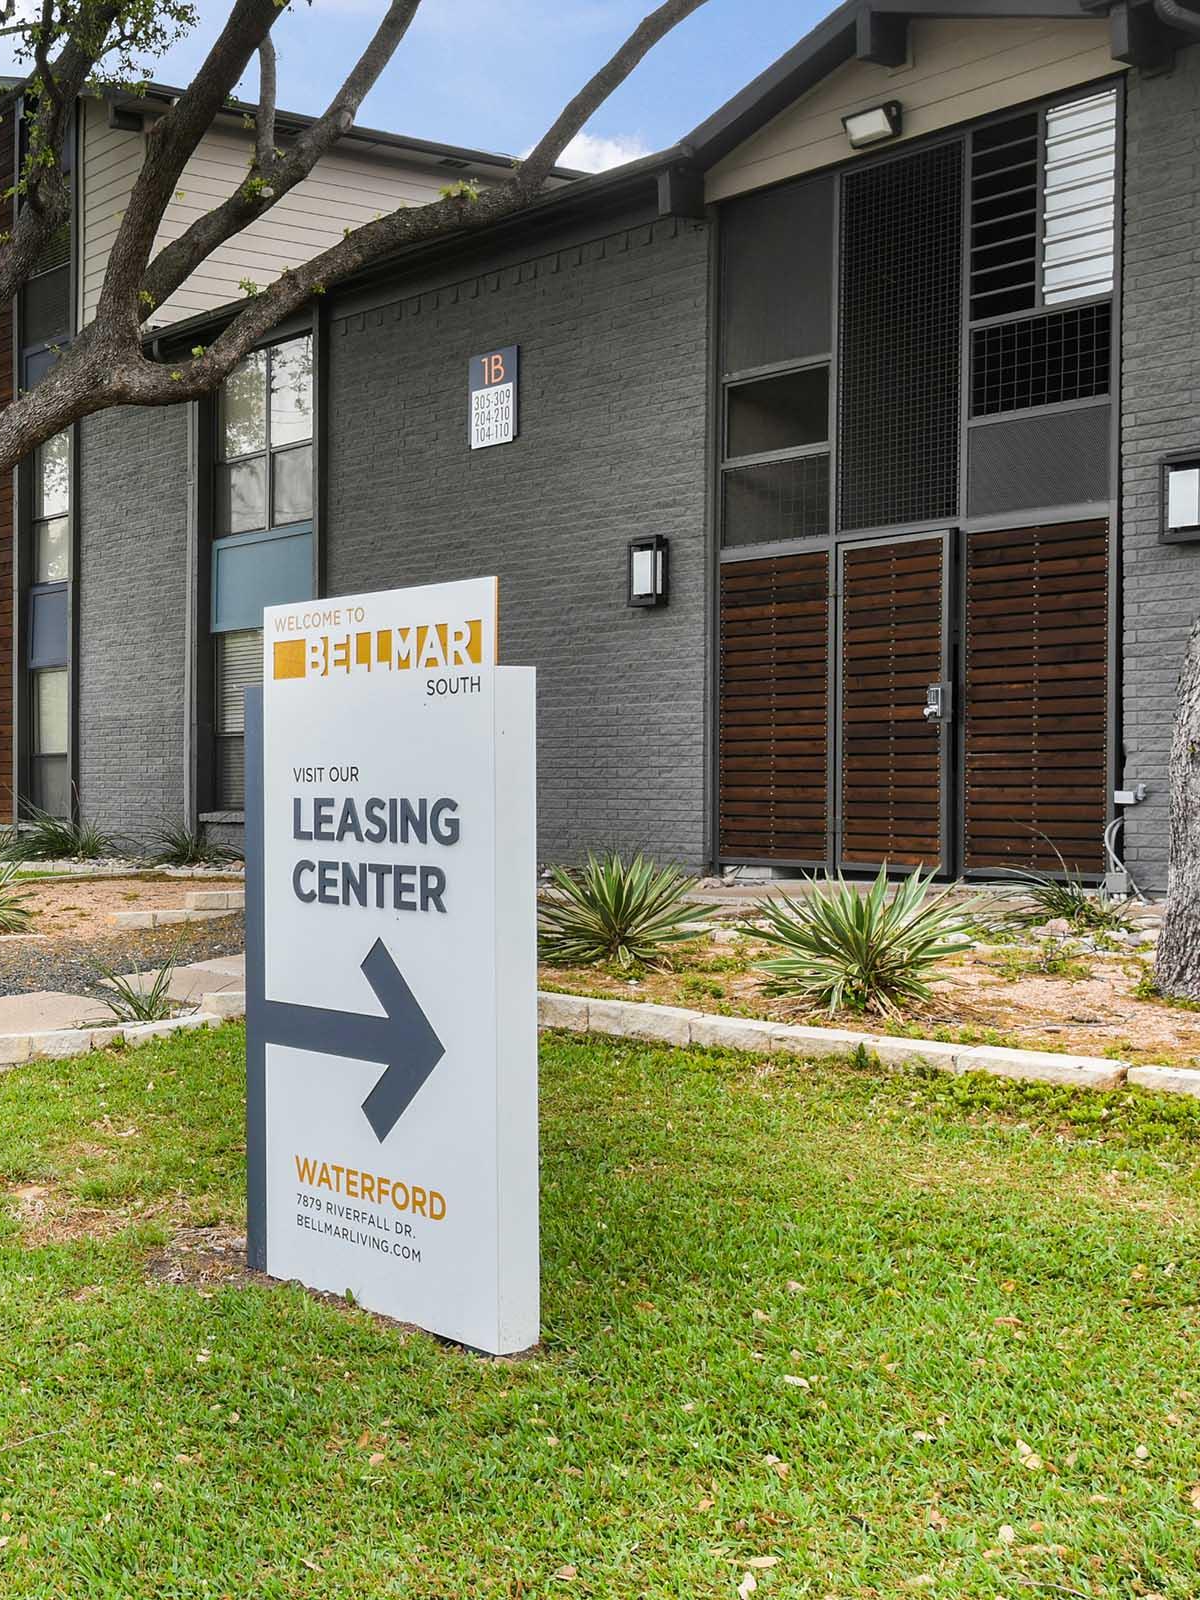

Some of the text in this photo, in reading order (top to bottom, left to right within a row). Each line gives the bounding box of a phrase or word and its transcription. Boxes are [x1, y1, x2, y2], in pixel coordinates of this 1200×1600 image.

[480, 353, 506, 385] 1B
[474, 388, 511, 411] 305-309
[474, 405, 510, 427] 204-210
[475, 422, 510, 442] 104-110
[274, 607, 365, 632] WELCOME TO
[307, 620, 472, 677] BELLMAR
[426, 676, 481, 696] SOUTH
[293, 766, 359, 783] VISIT OUR
[292, 797, 461, 846] LEASING
[292, 859, 448, 913] CENTER
[295, 1154, 447, 1221] WATERFORD
[296, 1193, 416, 1240] 7879 RIVERFALL DR.
[296, 1213, 422, 1264] BELLMARLIVING.COM
